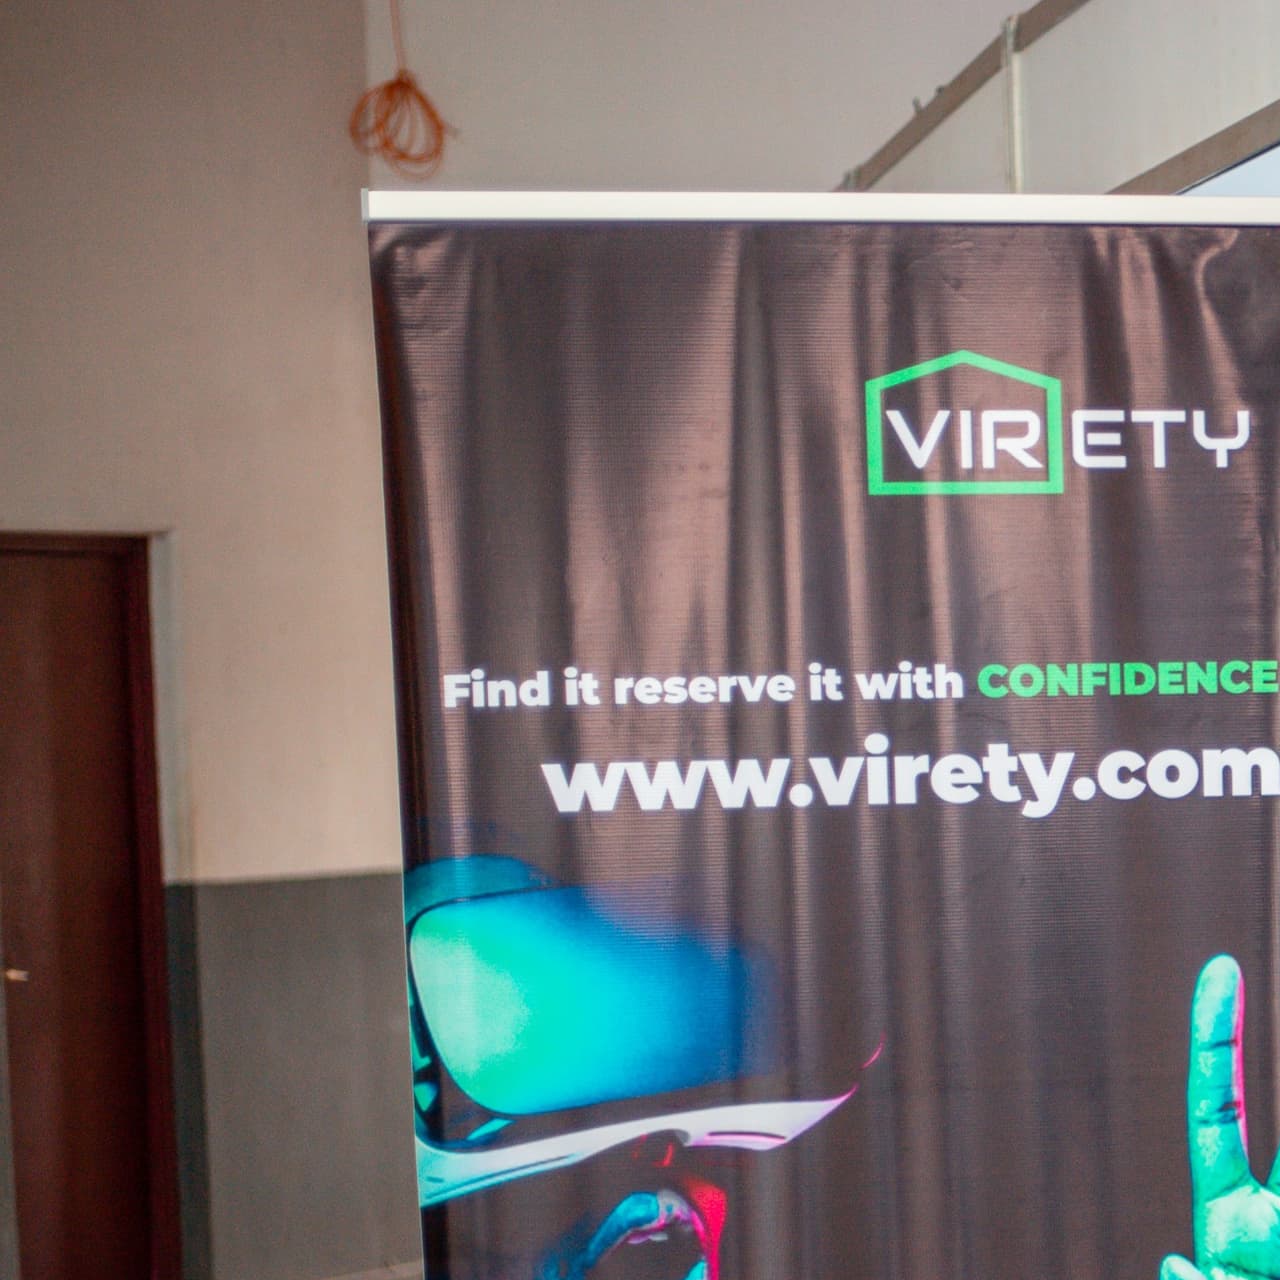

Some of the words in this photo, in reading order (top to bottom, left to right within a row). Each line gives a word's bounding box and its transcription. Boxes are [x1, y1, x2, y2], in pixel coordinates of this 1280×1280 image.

[886, 408, 1251, 470] VIRETY
[442, 667, 552, 710] Find
[564, 664, 600, 707] it
[614, 670, 796, 707] reserve
[808, 661, 844, 703] it
[854, 661, 965, 701] with
[976, 659, 1279, 700] CONFIDENCE
